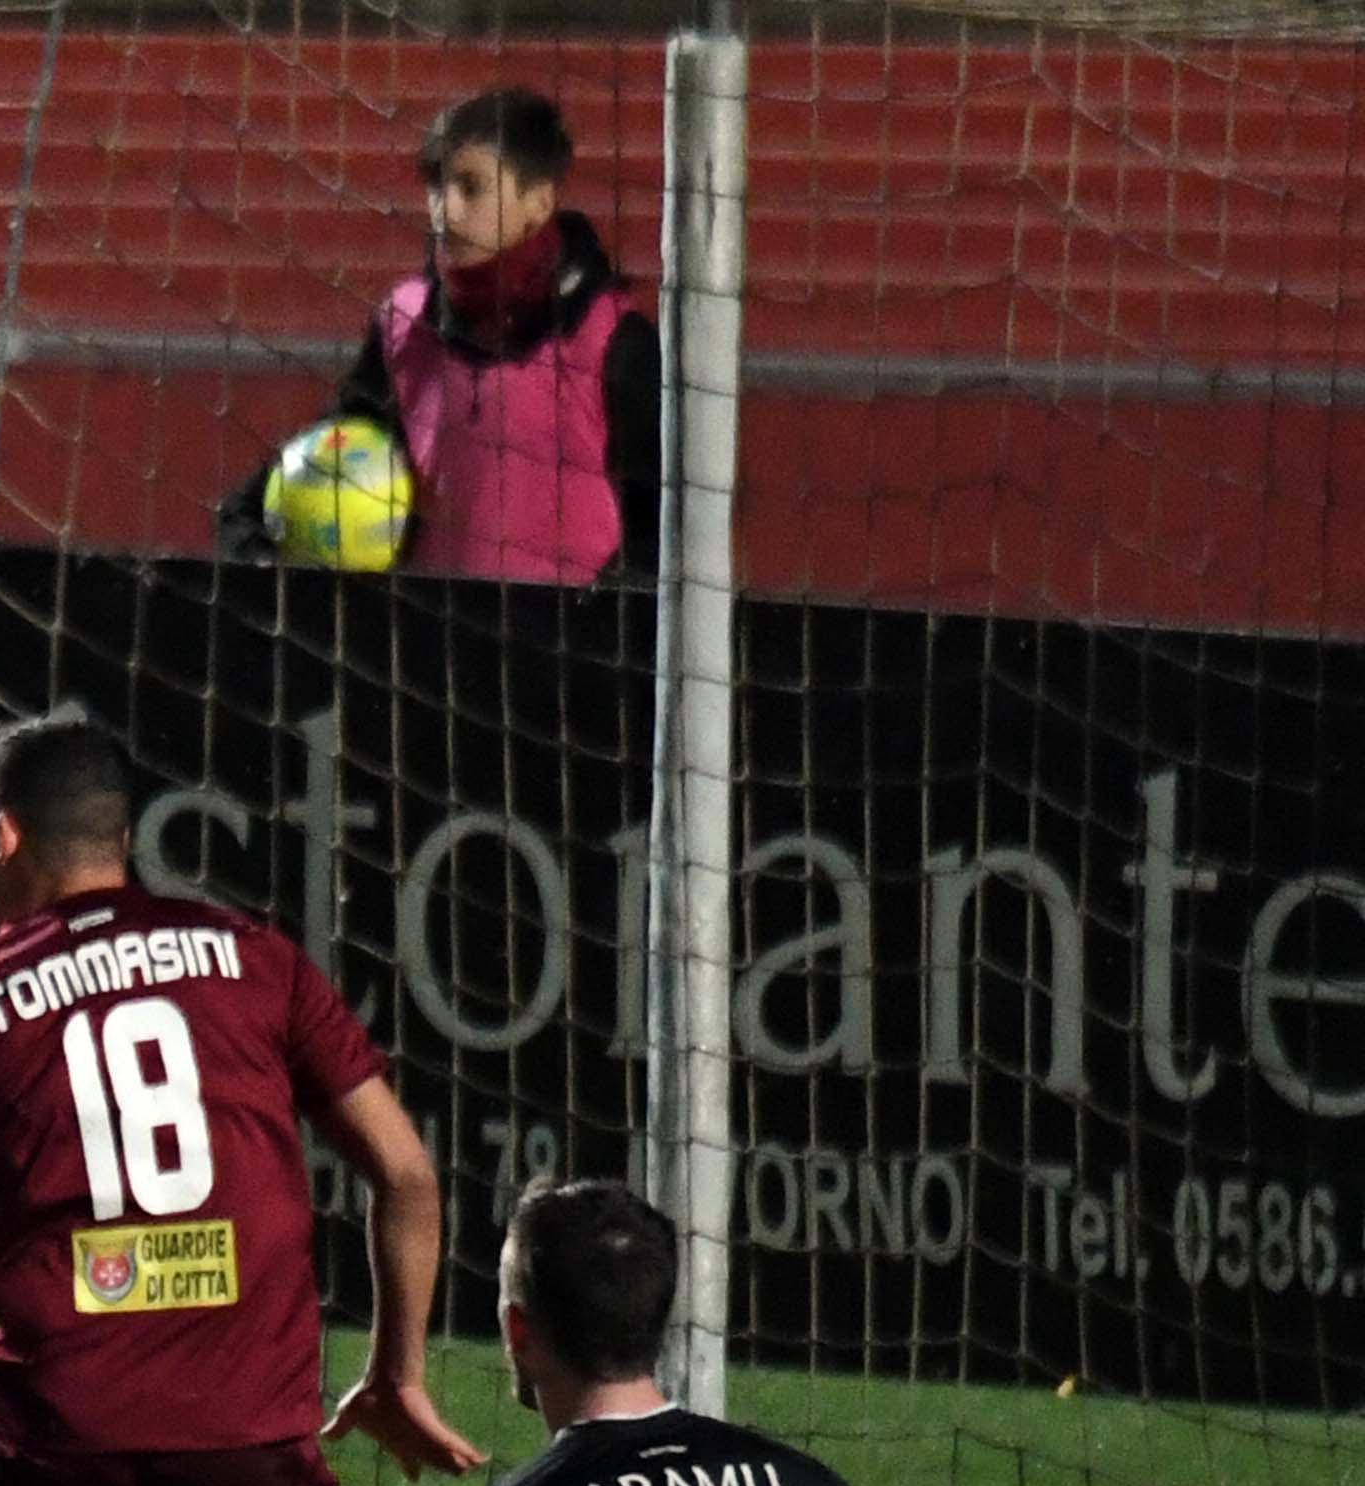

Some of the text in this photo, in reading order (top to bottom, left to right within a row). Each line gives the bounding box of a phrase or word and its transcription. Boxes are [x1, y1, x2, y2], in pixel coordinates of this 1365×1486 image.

[62, 996, 215, 1222] 18
[141, 1228, 227, 1263] GUARDIE
[1035, 1164, 1150, 1281] Tel.
[145, 1276, 165, 1302] DI
